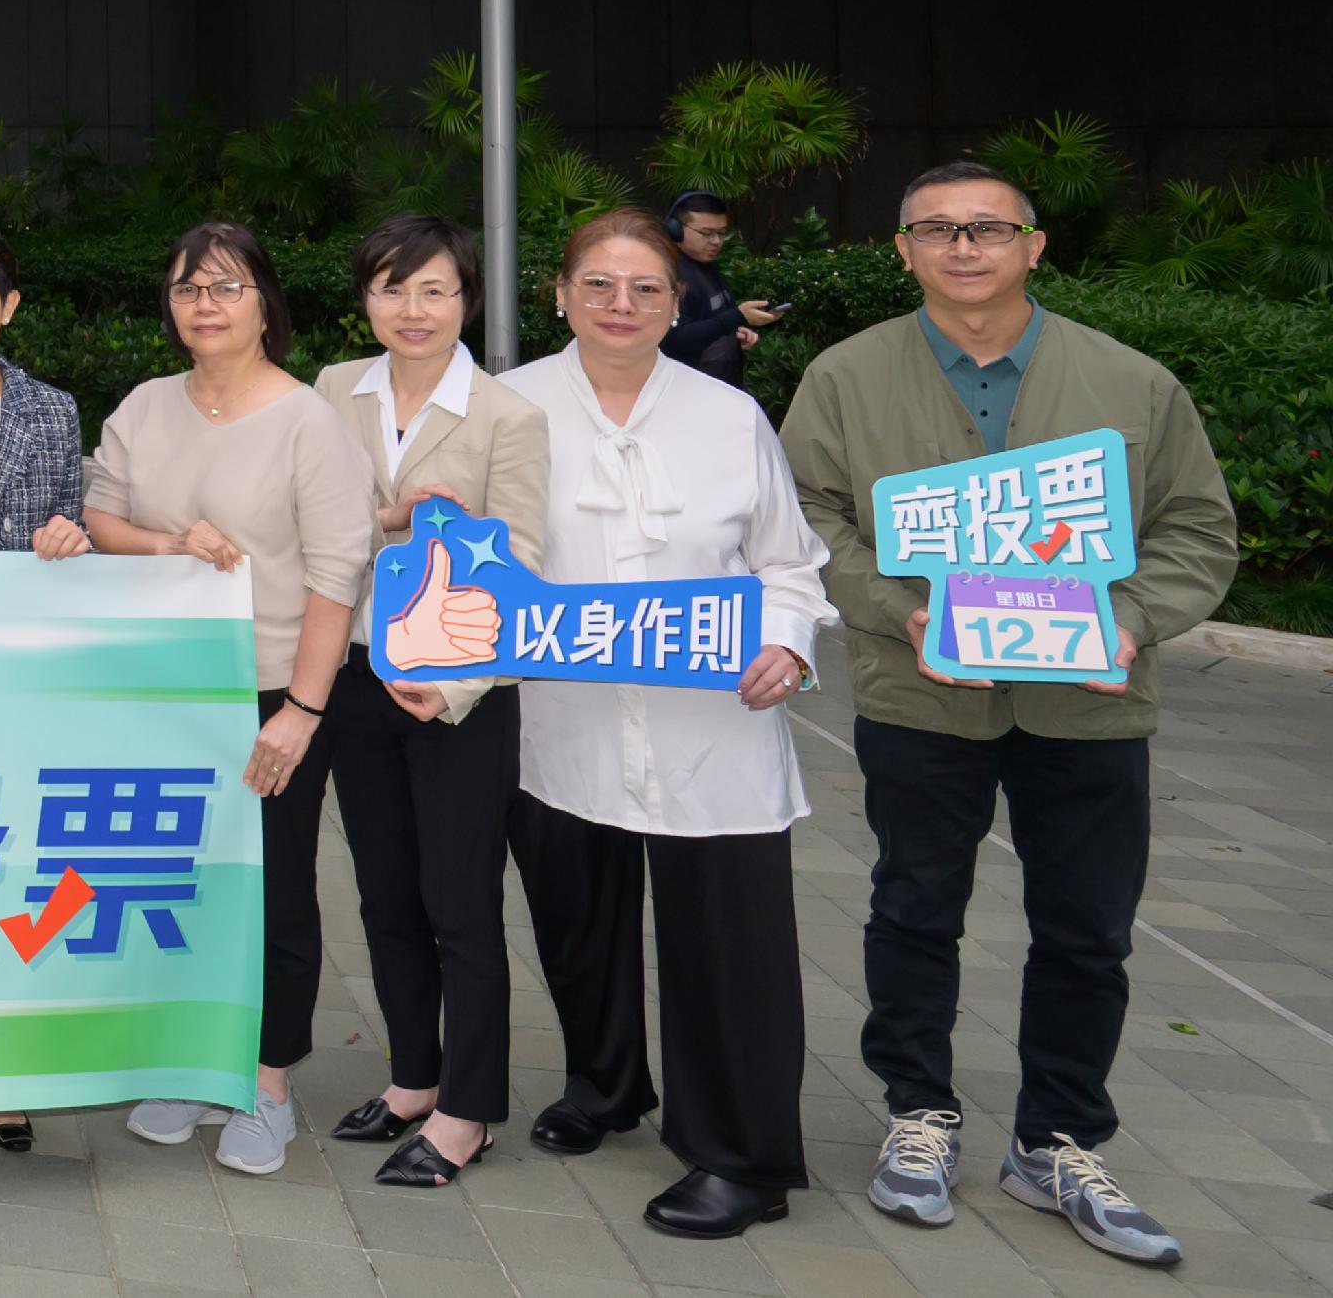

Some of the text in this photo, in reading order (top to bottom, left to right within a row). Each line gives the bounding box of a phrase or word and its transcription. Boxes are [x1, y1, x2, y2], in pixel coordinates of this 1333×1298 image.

[891, 448, 1114, 564] 齊投票
[995, 591, 1057, 609] 星期日
[516, 594, 743, 672] 以身作則
[965, 617, 1090, 663] 12.7
